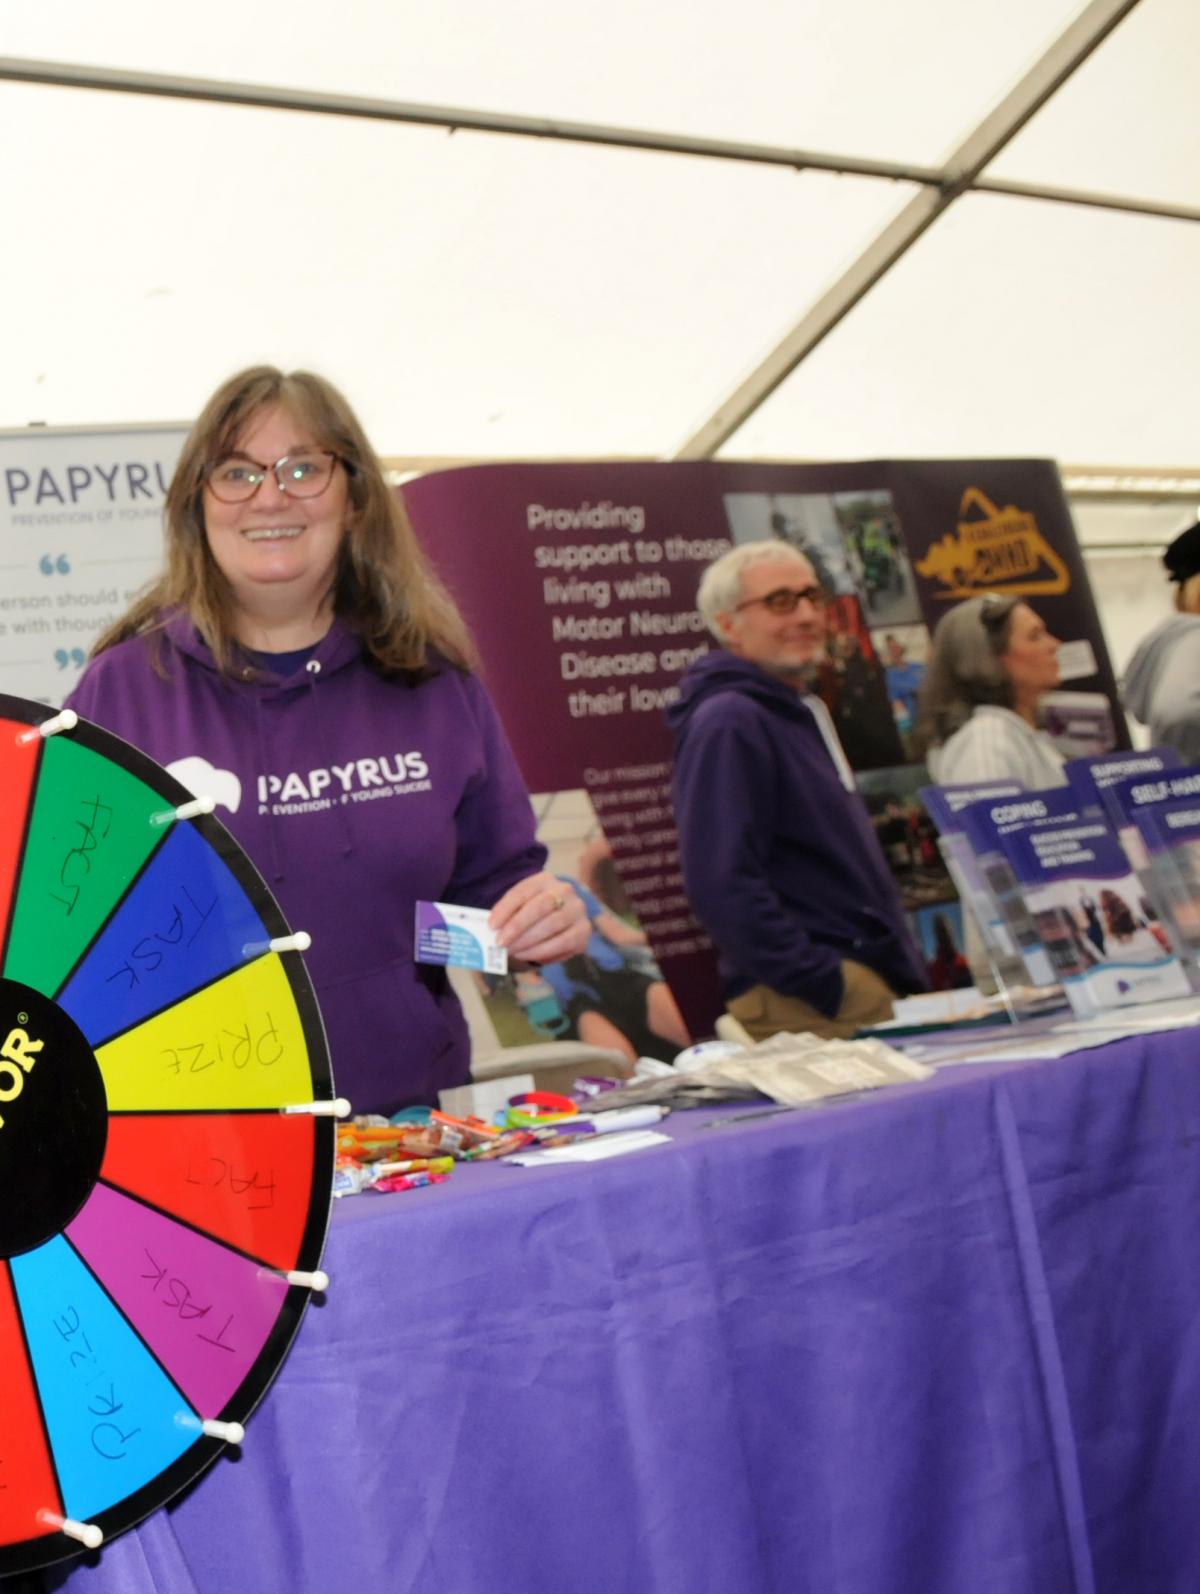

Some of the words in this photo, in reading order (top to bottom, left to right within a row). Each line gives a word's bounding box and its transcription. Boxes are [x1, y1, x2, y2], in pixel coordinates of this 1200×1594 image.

[527, 501, 645, 533] Providing
[534, 541, 633, 572] support
[634, 540, 663, 563] to
[56, 589, 118, 607] should
[544, 575, 611, 609] living
[614, 571, 671, 600] with
[13, 617, 51, 635] with
[553, 614, 625, 642] Motor
[629, 610, 707, 636] Neuro
[560, 650, 657, 680] Disease
[567, 686, 627, 718] their
[629, 684, 681, 711] love
[257, 751, 430, 804] PAPYRUS
[258, 797, 331, 816] PEVENTION
[350, 785, 393, 804] YOUNG
[394, 779, 432, 796] SUICIDE
[49, 794, 113, 916] FACT
[106, 885, 218, 989] TASK
[161, 1011, 284, 1076] PRIZE
[184, 1158, 276, 1210] FACT
[140, 1247, 236, 1353] TASK
[52, 1304, 142, 1461] PRIZE
